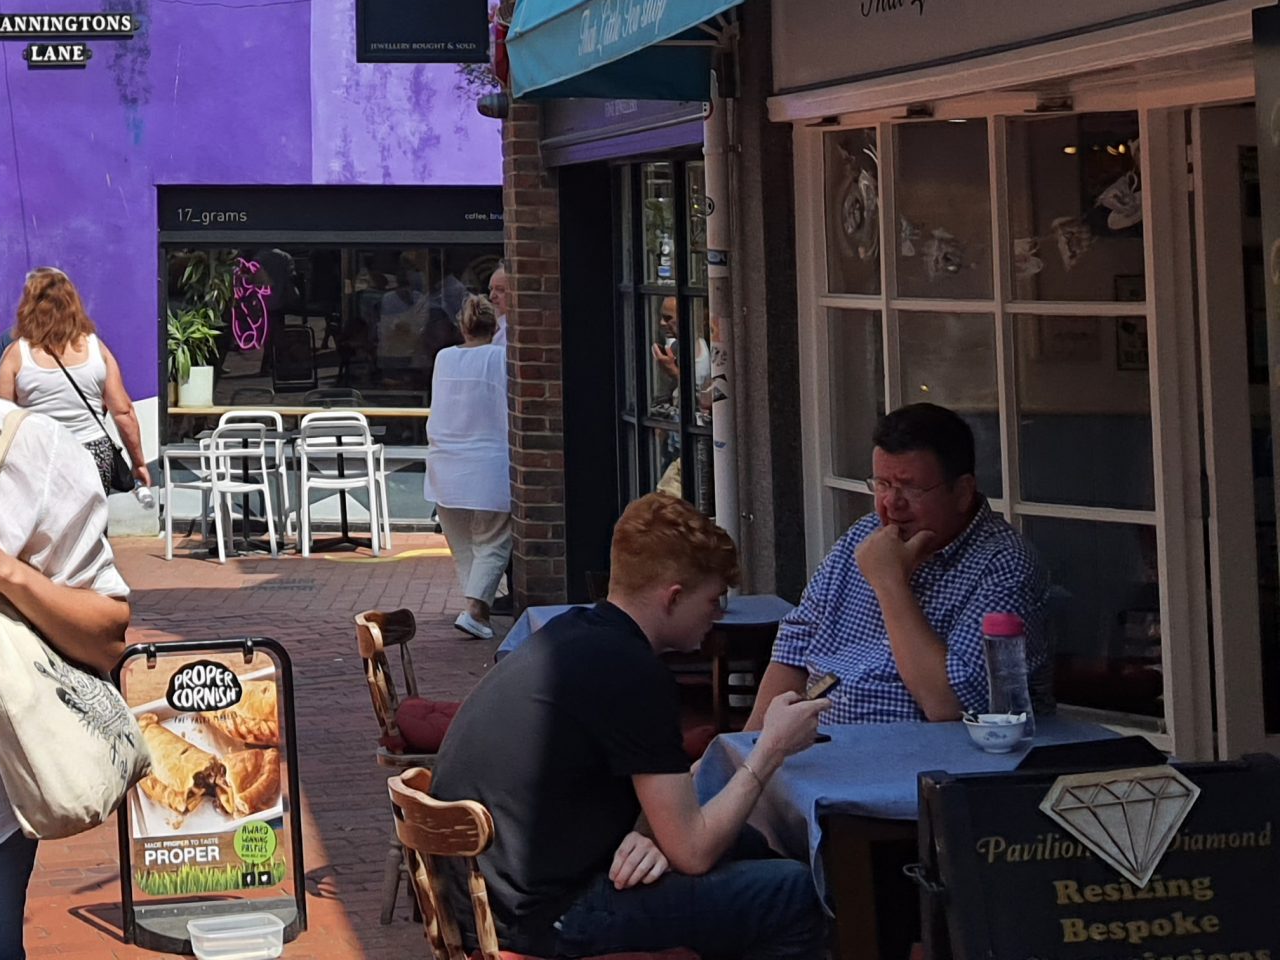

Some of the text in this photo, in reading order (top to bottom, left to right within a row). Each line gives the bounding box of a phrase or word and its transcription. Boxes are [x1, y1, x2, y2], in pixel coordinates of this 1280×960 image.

[31, 45, 84, 61] LANE
[371, 42, 410, 50] JEWELLERY
[412, 42, 445, 50] BOUGHT
[456, 42, 476, 50] SOLD
[178, 208, 248, 226] 17_grams
[174, 665, 233, 690] PROPER
[173, 686, 236, 709] CORNISH
[241, 825, 269, 835] AWARD
[144, 841, 161, 849] MADE
[163, 840, 189, 848] PROPER
[144, 846, 220, 866] PROPER
[1060, 910, 1220, 944] Bespoke
